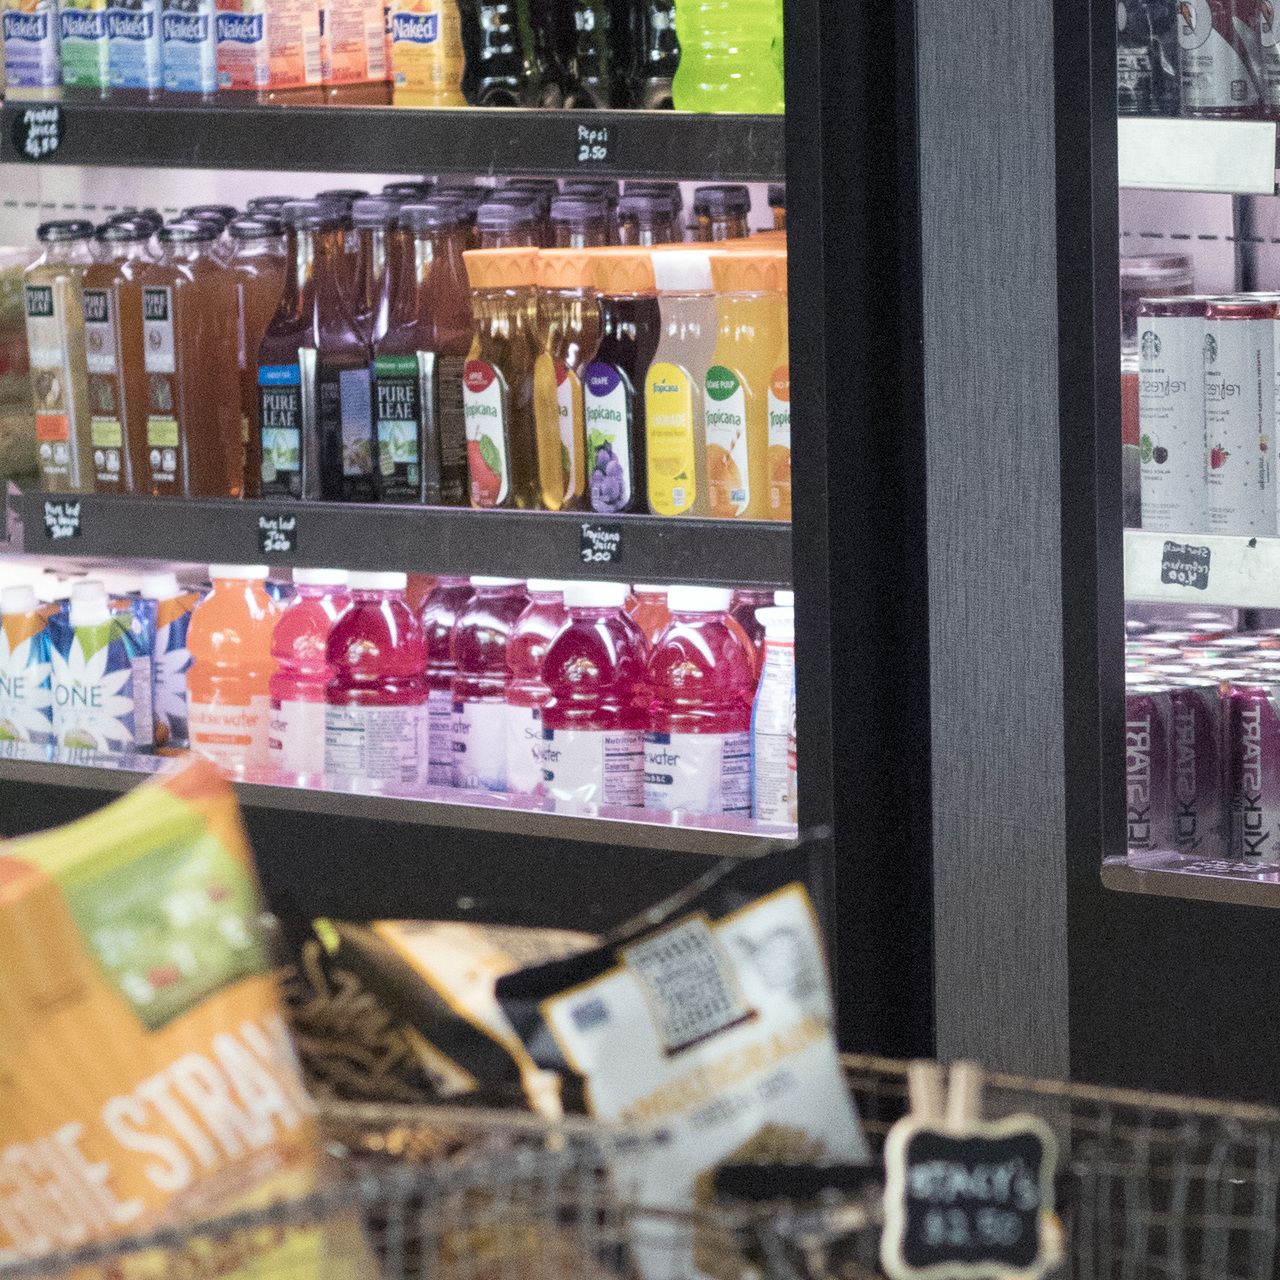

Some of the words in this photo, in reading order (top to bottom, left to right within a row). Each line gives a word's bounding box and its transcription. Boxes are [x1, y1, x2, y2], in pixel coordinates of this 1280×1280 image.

[219, 19, 259, 39] Naked
[577, 124, 608, 143] Pepsi
[577, 144, 607, 161] 2.50
[263, 394, 298, 410] PURE
[377, 385, 415, 402] PURE
[263, 410, 295, 426] LEAF
[378, 402, 413, 419] LEAF
[54, 682, 104, 709] ONE
